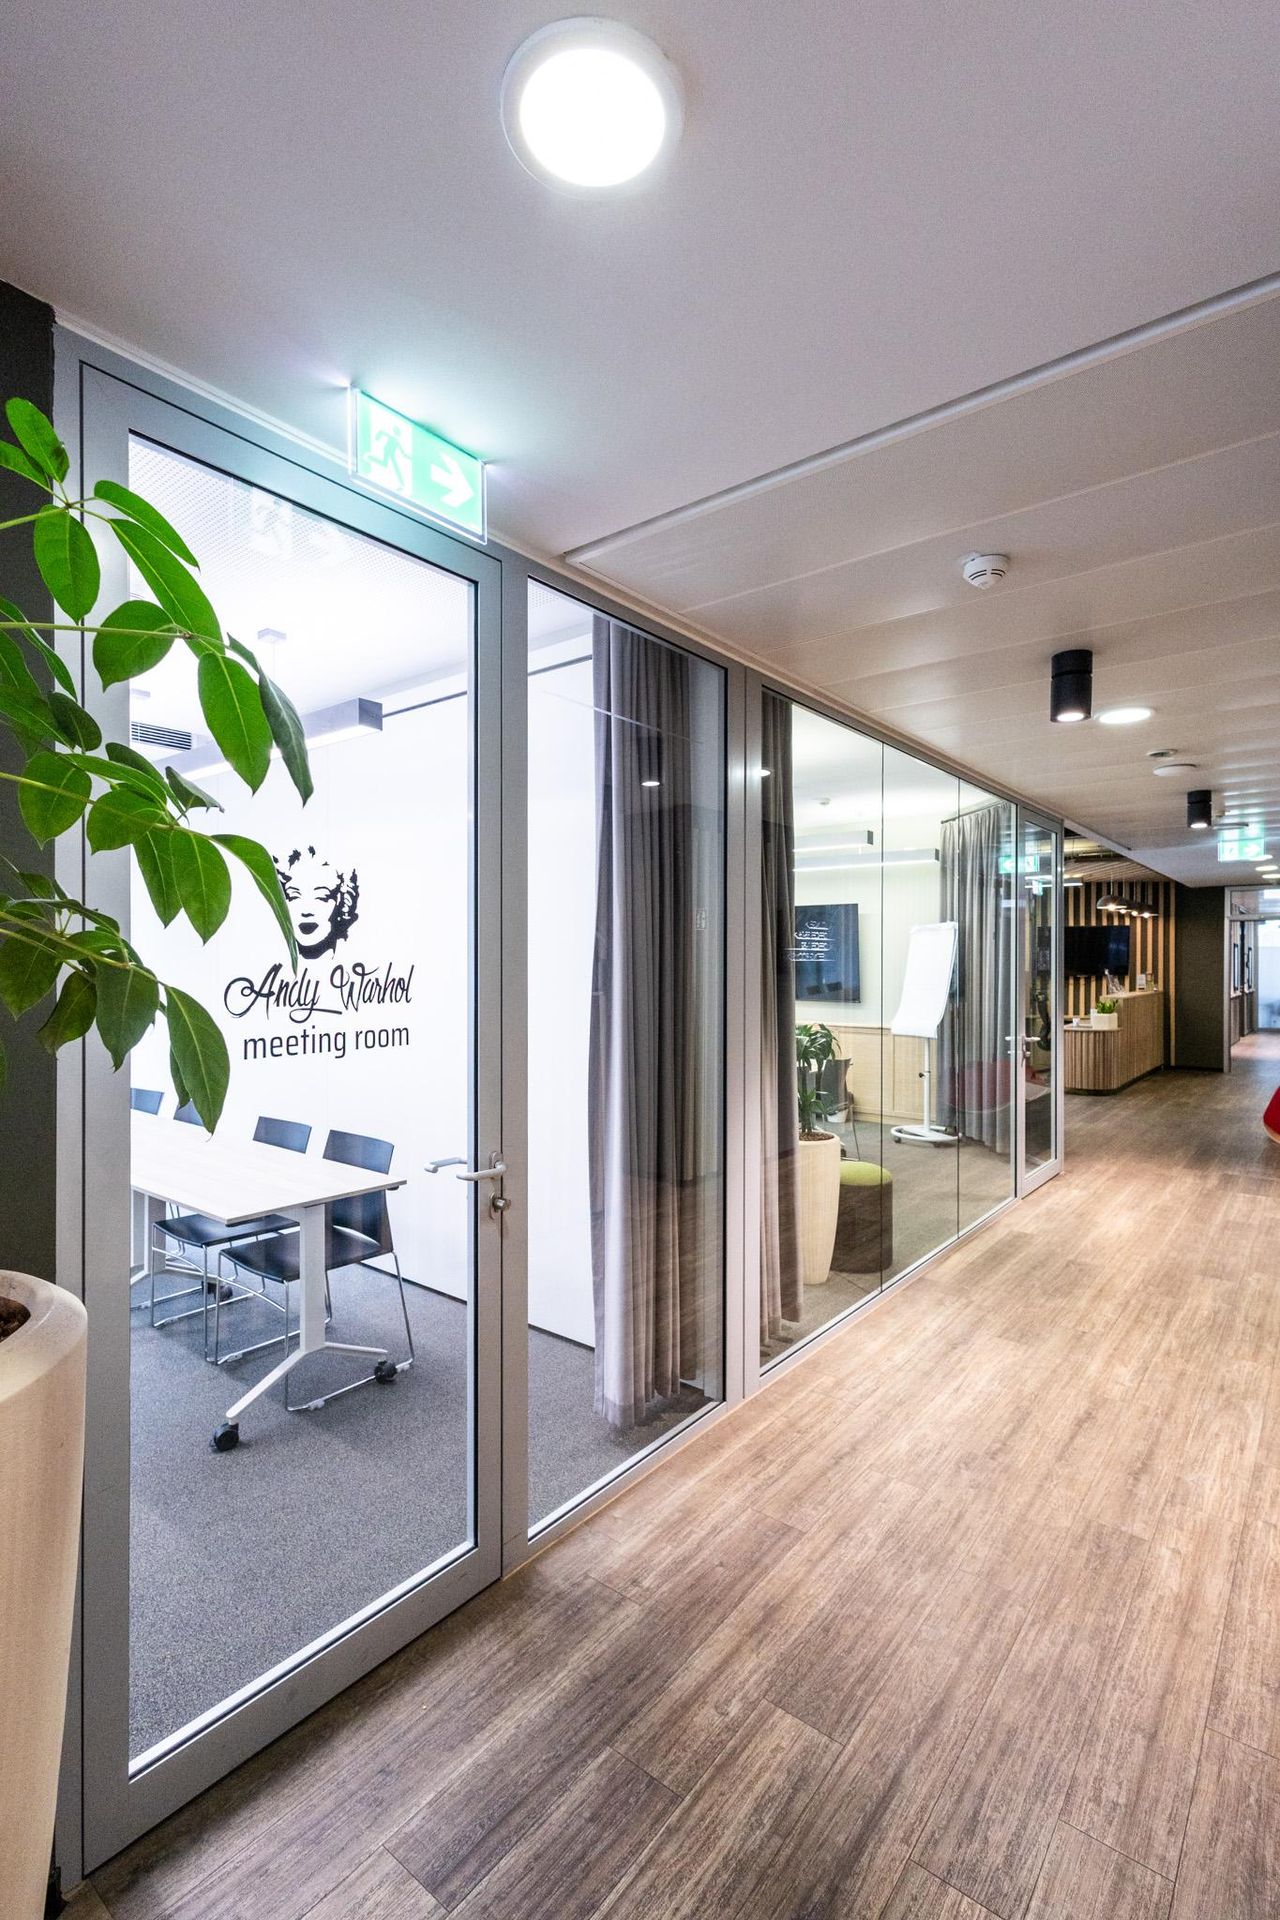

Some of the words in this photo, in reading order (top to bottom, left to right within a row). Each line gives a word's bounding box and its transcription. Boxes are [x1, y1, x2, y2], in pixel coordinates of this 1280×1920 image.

[224, 962, 342, 1023] Andy
[330, 962, 414, 1012] Warhol
[243, 1025, 346, 1060] meeting
[355, 1027, 409, 1050] room
